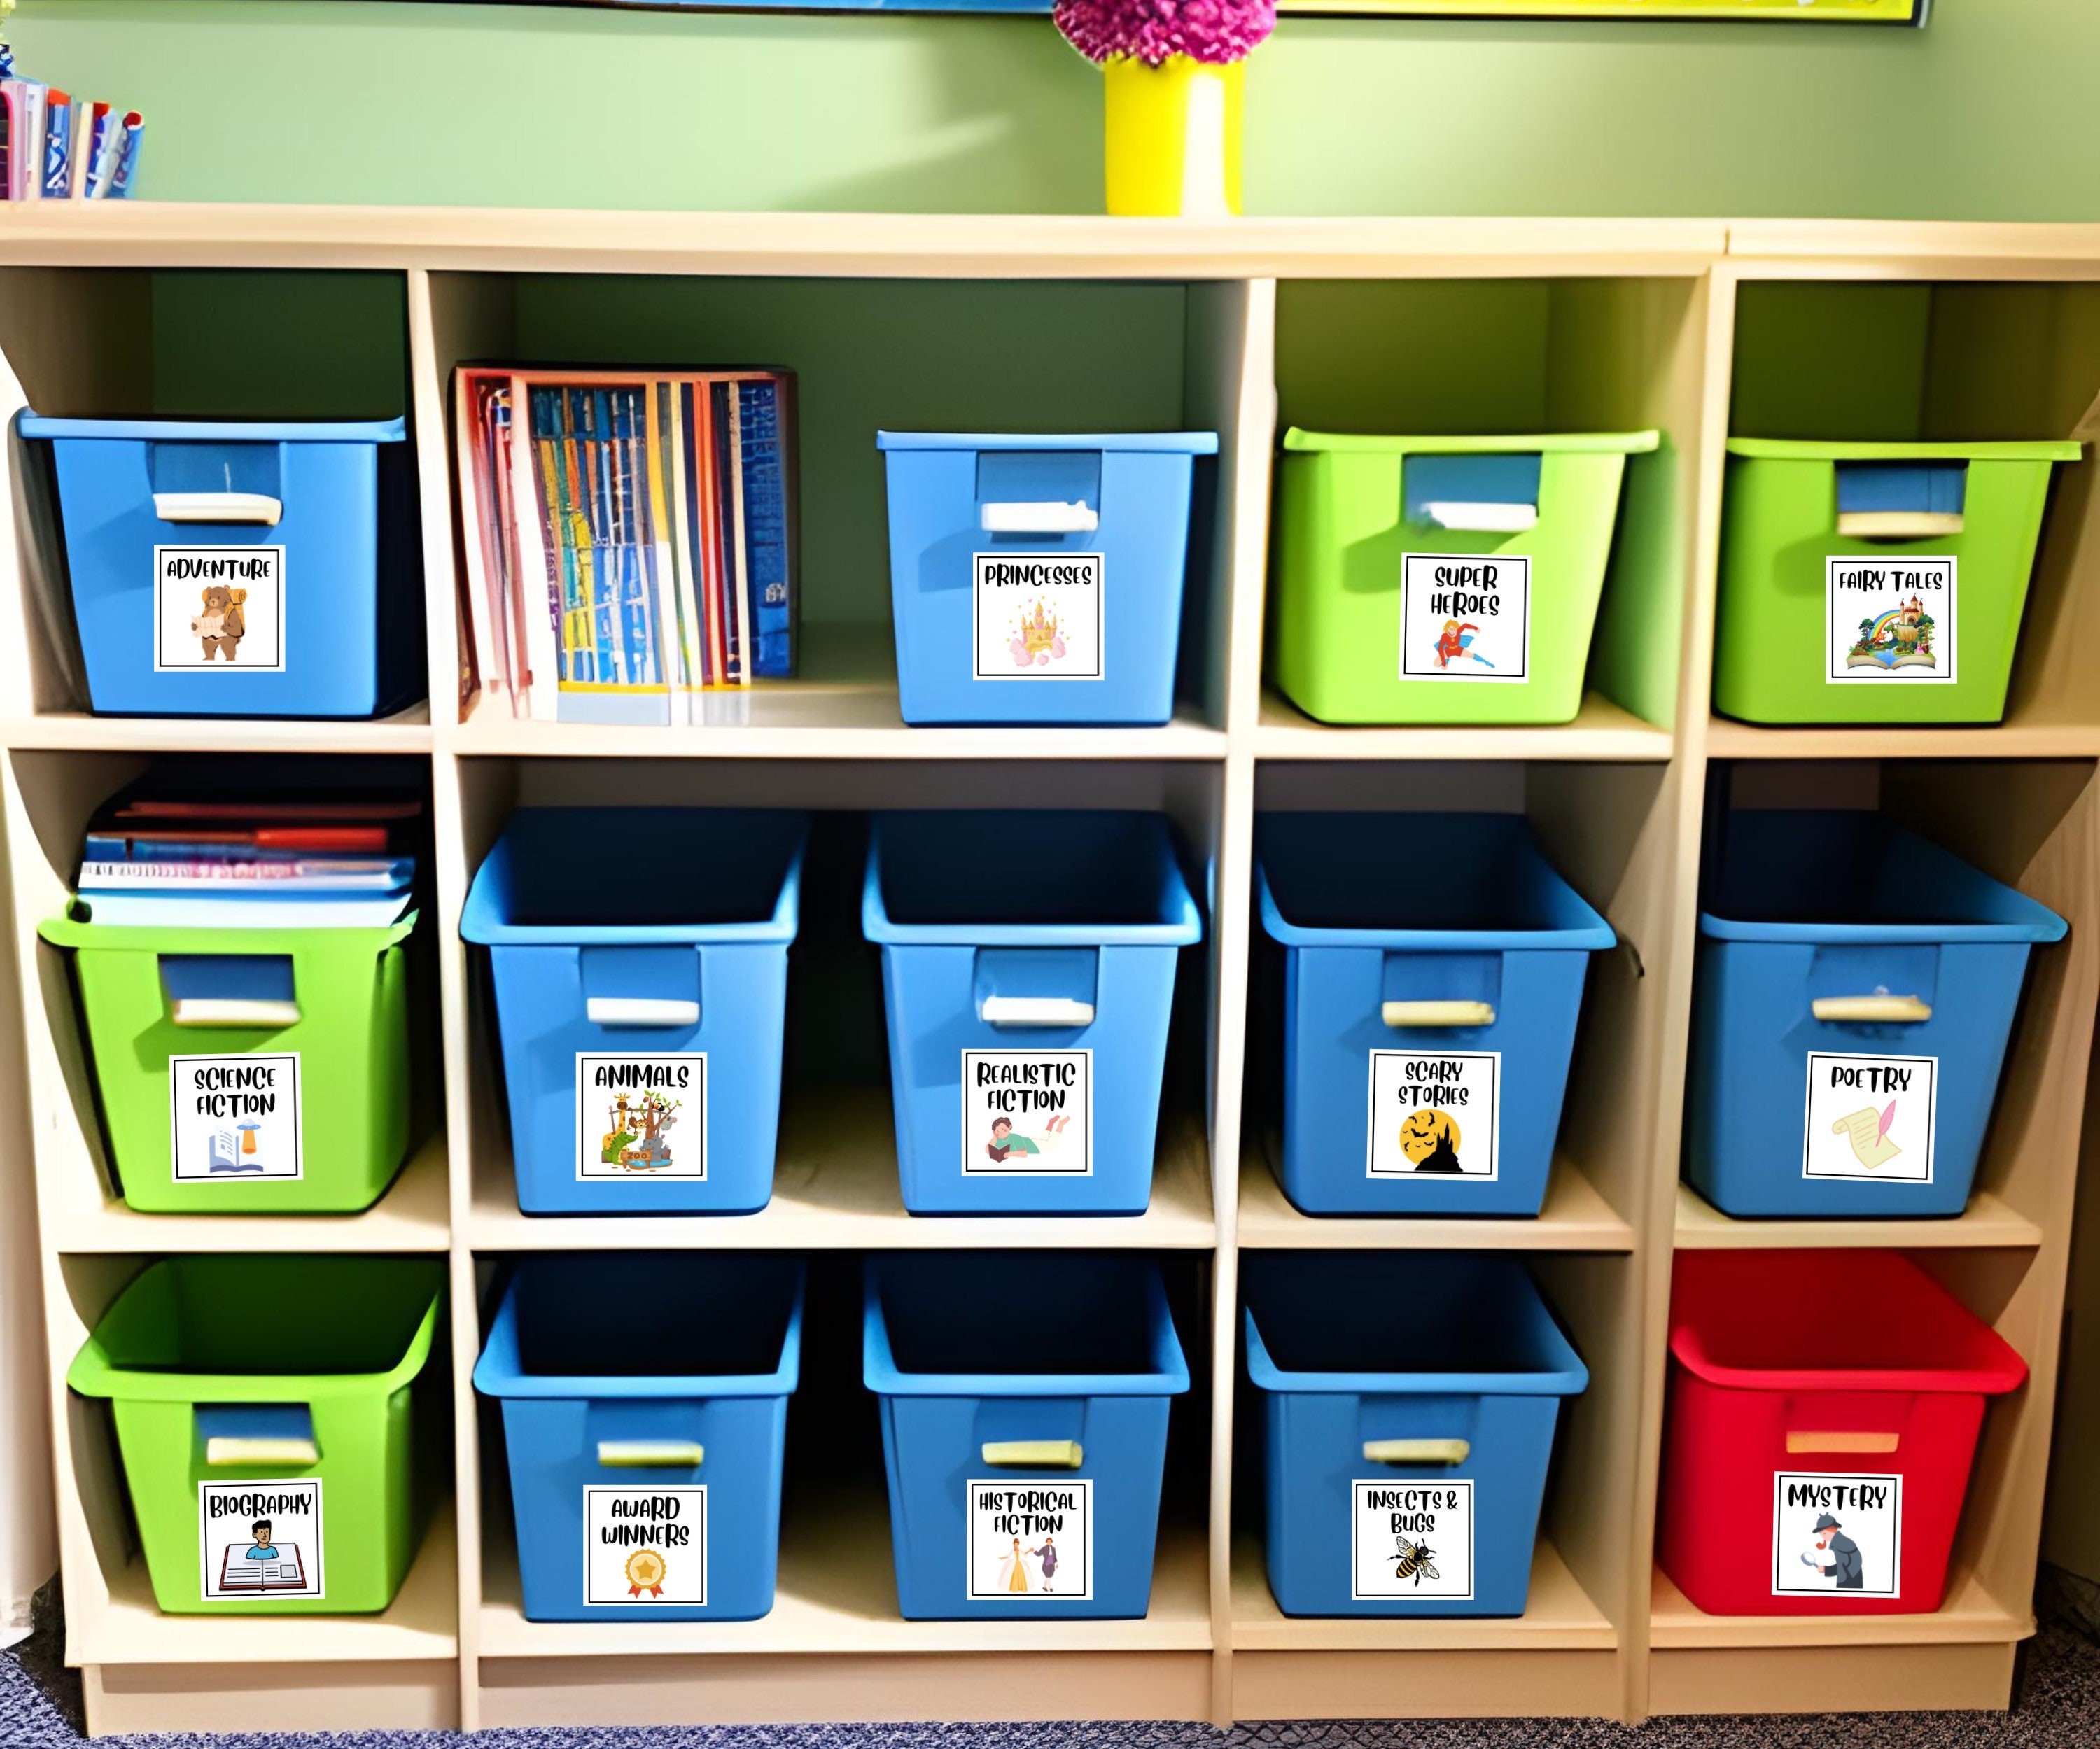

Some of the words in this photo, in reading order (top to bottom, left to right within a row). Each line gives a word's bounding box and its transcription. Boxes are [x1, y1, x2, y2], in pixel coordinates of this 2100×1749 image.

[167, 558, 271, 580] ADVENTURE
[984, 563, 1092, 588] PRINCESSES
[1434, 564, 1498, 591] SUPER
[1839, 569, 1886, 592] FAIRY
[1890, 570, 1942, 592] TALES
[1431, 591, 1500, 618] HEROES
[194, 1066, 276, 1091] SCIENCE
[595, 1064, 689, 1089] ANIMALS
[976, 1062, 1076, 1088] REALISTIC
[1405, 1060, 1463, 1083] SCARY
[1830, 1066, 1912, 1093] POETRY
[197, 1093, 275, 1118] FICTION
[987, 1088, 1065, 1113] FICTION
[1398, 1084, 1469, 1107] STORIES
[627, 1151, 648, 1160] ZOO
[209, 1493, 312, 1519] BIOGRAPHY
[611, 1496, 680, 1522] AWARD
[979, 1490, 1077, 1513] HISTORICAL
[1367, 1489, 1442, 1512] INSECTS
[1446, 1490, 1458, 1510] &
[1788, 1484, 1887, 1511] MYSTERY
[994, 1514, 1063, 1536] FICTION
[1390, 1512, 1435, 1534] BUGS
[601, 1523, 690, 1549] WINNERS
